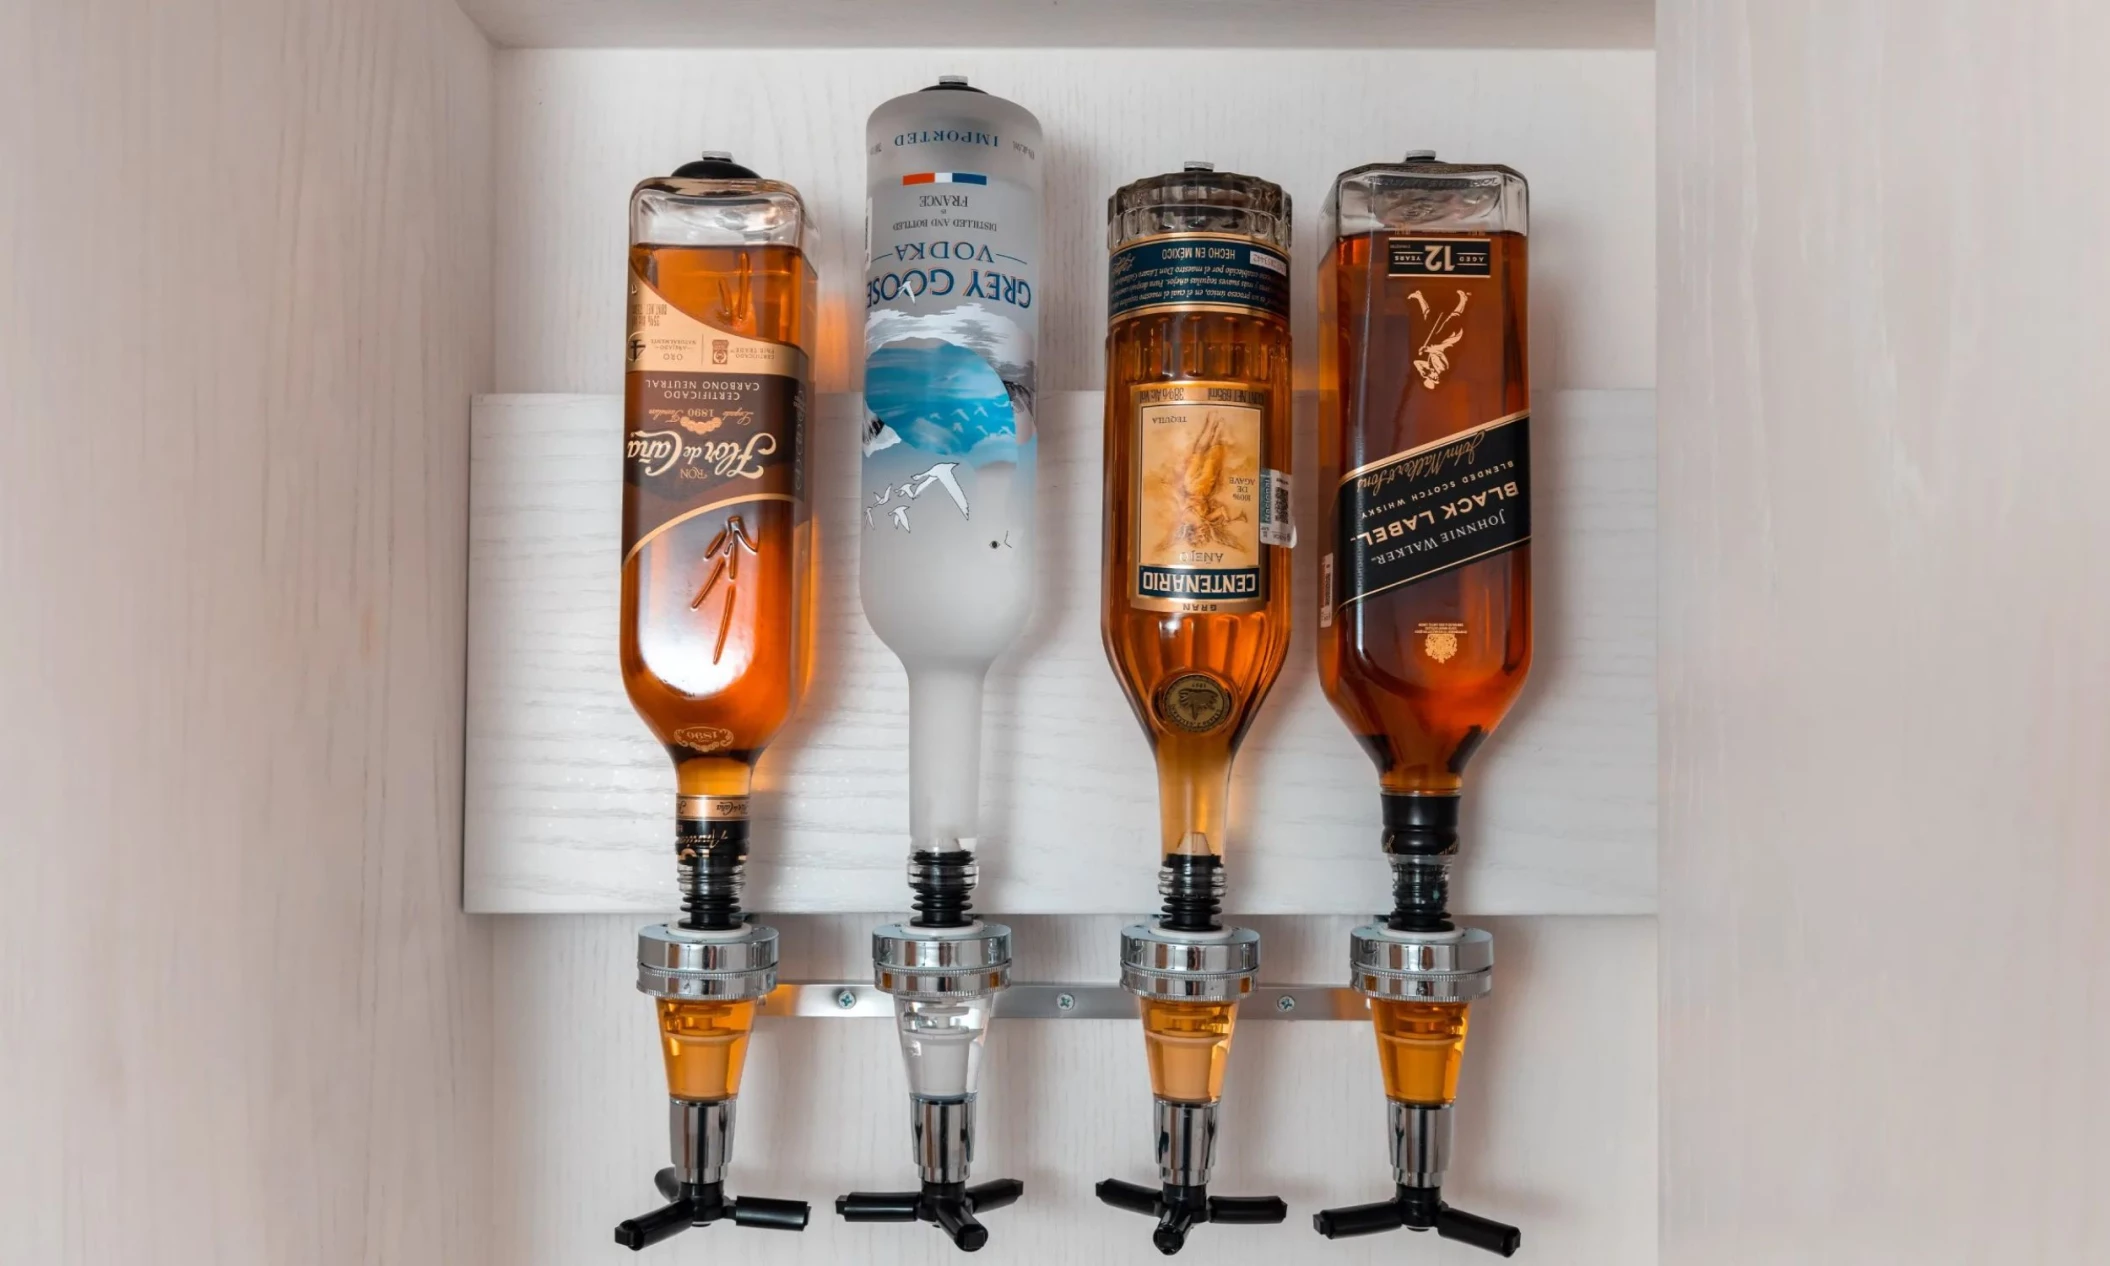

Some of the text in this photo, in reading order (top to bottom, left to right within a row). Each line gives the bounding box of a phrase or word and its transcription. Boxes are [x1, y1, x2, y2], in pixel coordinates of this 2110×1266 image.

[894, 130, 998, 146] IMPORTED
[919, 195, 968, 207] FRANCE
[893, 219, 997, 231] DISTILLED AND BOTTLED
[894, 241, 994, 263] VODKA
[1162, 247, 1235, 260] HECHO EN MÉXICO
[1425, 245, 1455, 271] 12
[866, 268, 1031, 309] GREY GOOSE
[1228, 291, 1250, 299] proceso
[629, 340, 646, 362] 4
[645, 379, 760, 390] CARBONO NEUTRAL
[663, 390, 740, 401] CERTIFICADO
[688, 408, 714, 417] 1890
[626, 430, 683, 477] Caña
[683, 446, 702, 464] de
[704, 432, 776, 479] Flor
[679, 467, 708, 479] RON
[1394, 451, 1446, 483] Walker
[1229, 477, 1256, 485] AGAVE
[1360, 460, 1514, 519] BLENDED SCOTCH WHISKY
[1356, 481, 1519, 546] BLACK LABEL
[1375, 509, 1506, 564] JOHNNIE WALKER
[1179, 551, 1224, 564] AÑEJO
[1142, 572, 1256, 594] CENTENARIO
[1182, 604, 1217, 612] GRAN
